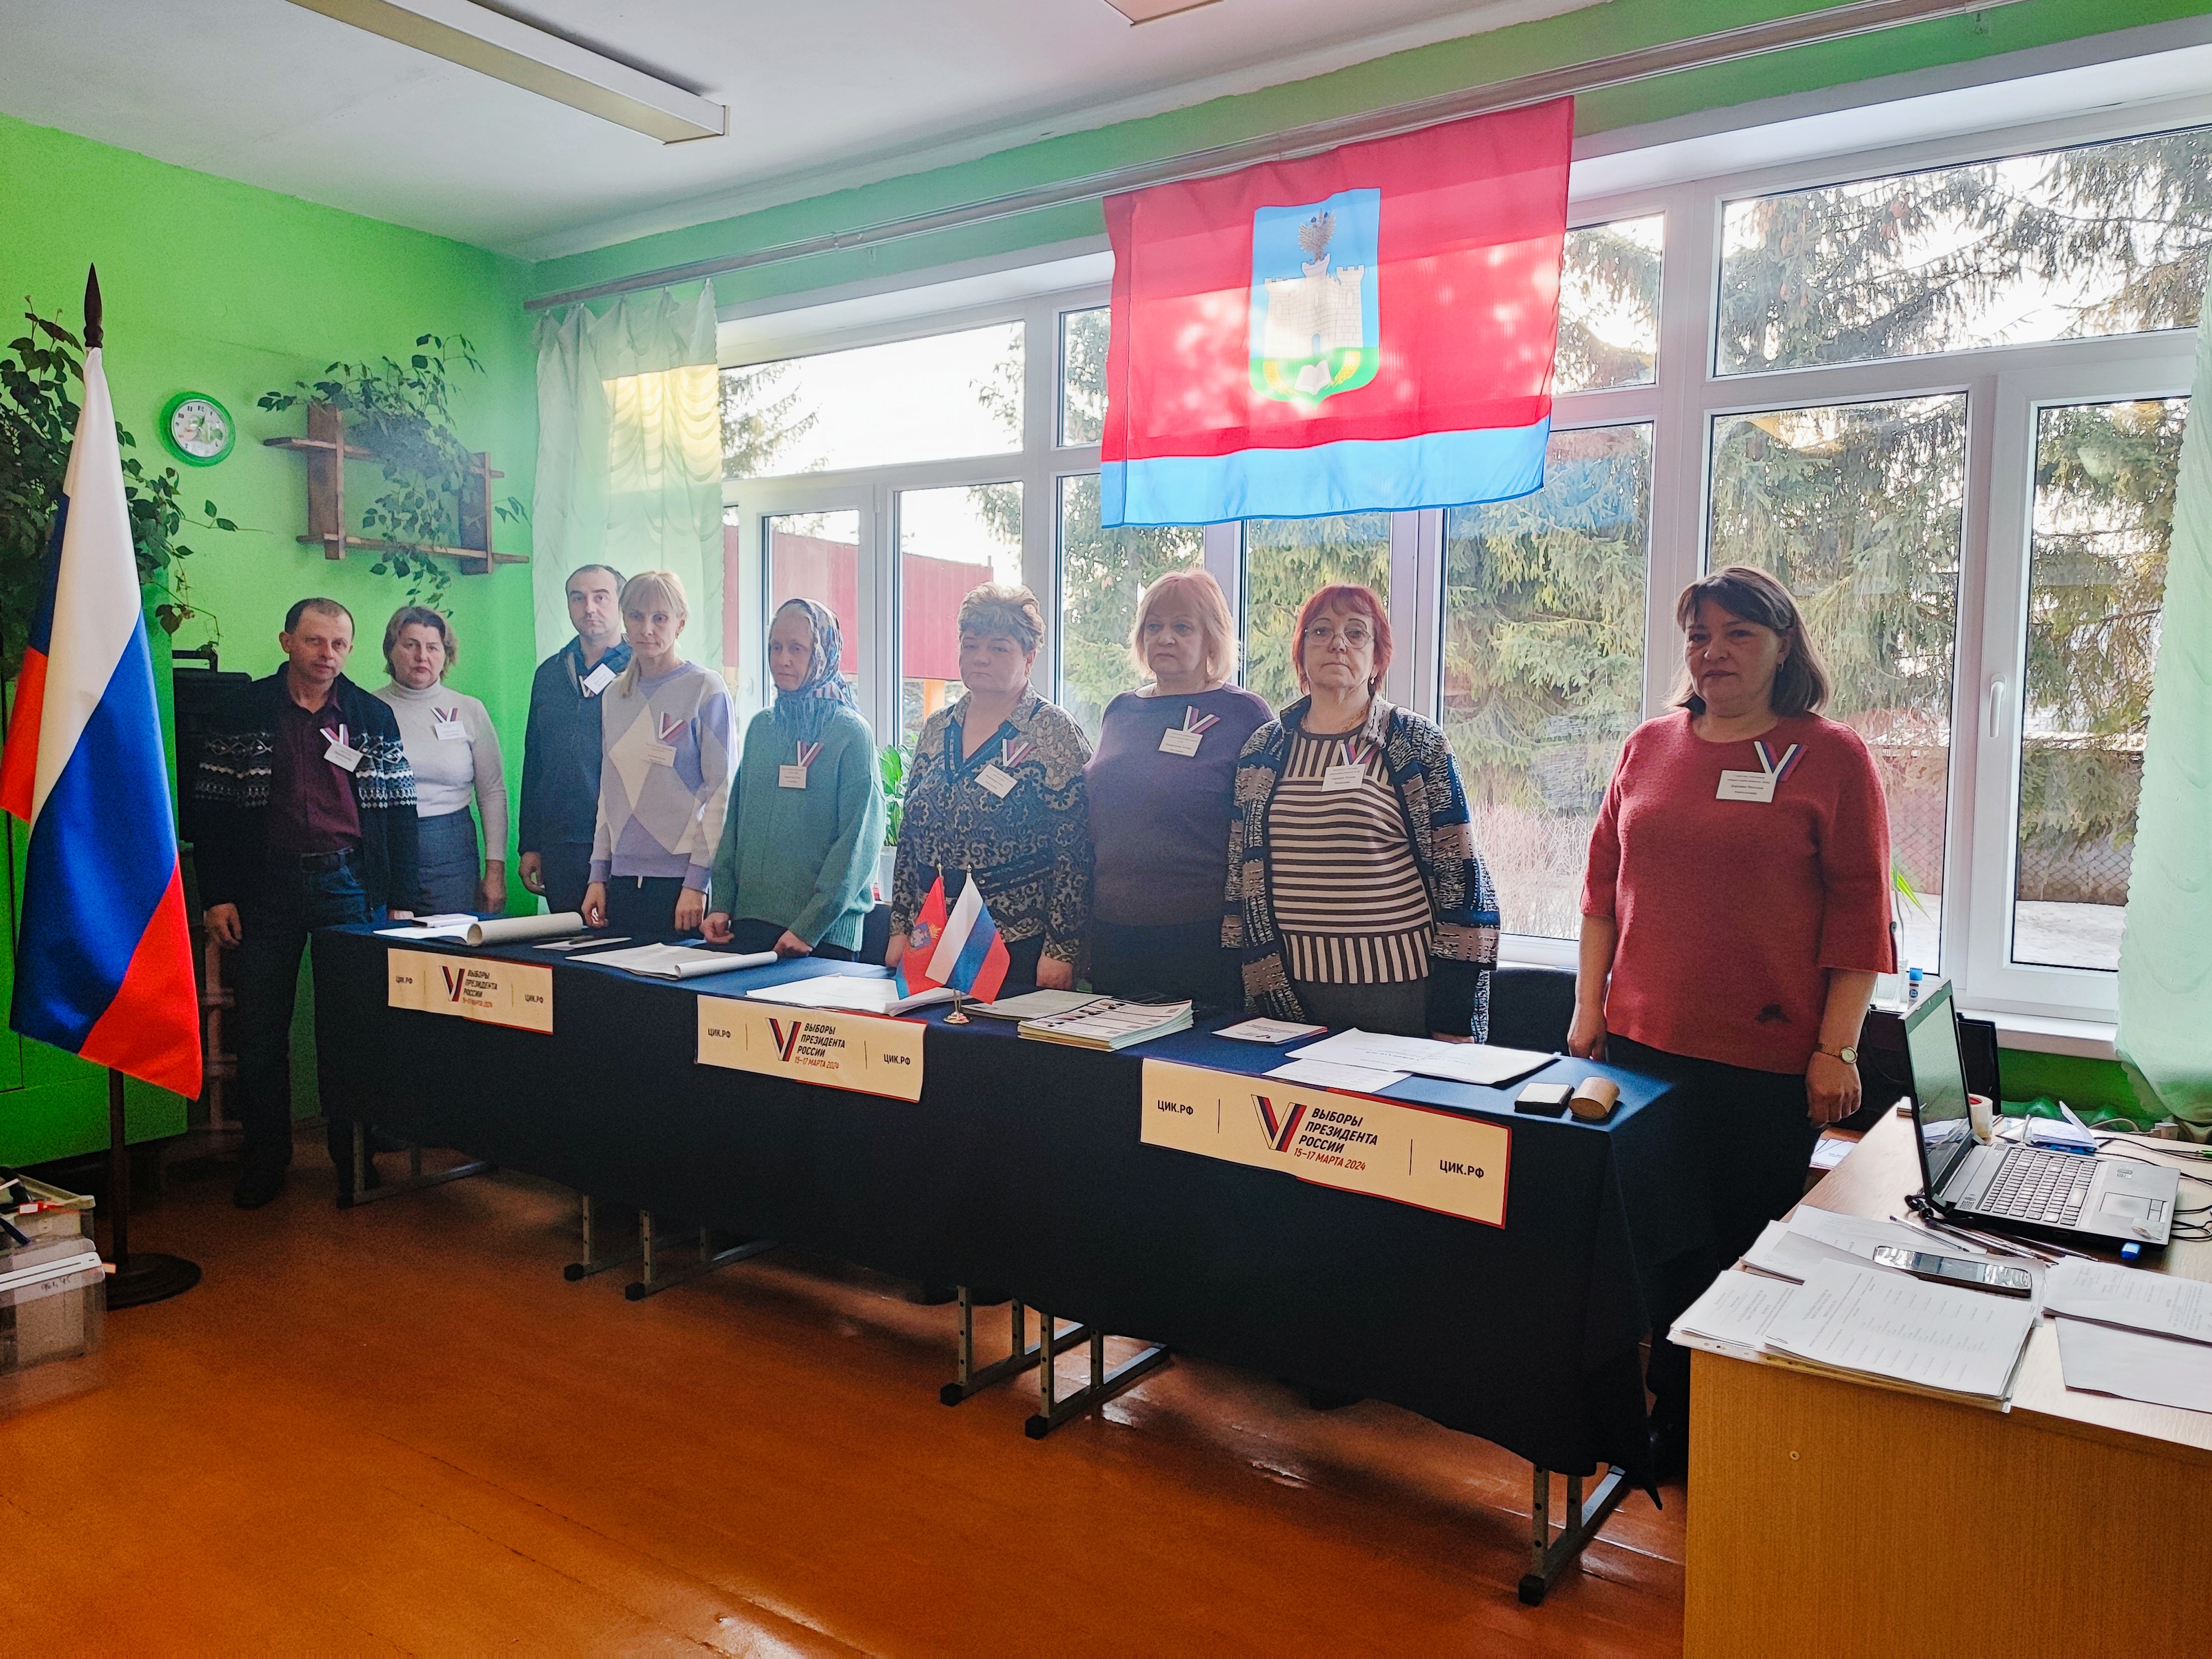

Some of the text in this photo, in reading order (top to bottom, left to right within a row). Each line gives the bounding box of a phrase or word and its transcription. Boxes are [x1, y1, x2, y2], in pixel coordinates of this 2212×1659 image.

[708, 1028, 731, 1039] ЦИК.РФ
[804, 1022, 836, 1035] ВЫБОРЫ
[800, 1034, 845, 1048] ПРЕЗИДЕНТА
[797, 1045, 826, 1057] РОССИИ
[808, 1058, 826, 1067] МАРТА
[884, 1053, 911, 1066] ЦИК.РФ
[1157, 1099, 1193, 1115] ЦИК.РФ
[1311, 1108, 1364, 1127] ВЫБОРЫ
[1305, 1121, 1378, 1146] ПРЕЗИДЕНТА
[1298, 1134, 1345, 1154] РОССИИ
[1315, 1153, 1344, 1167] МАРТА
[1344, 1159, 1366, 1171] 2024
[1439, 1159, 1484, 1178] ЦИК.РФ
